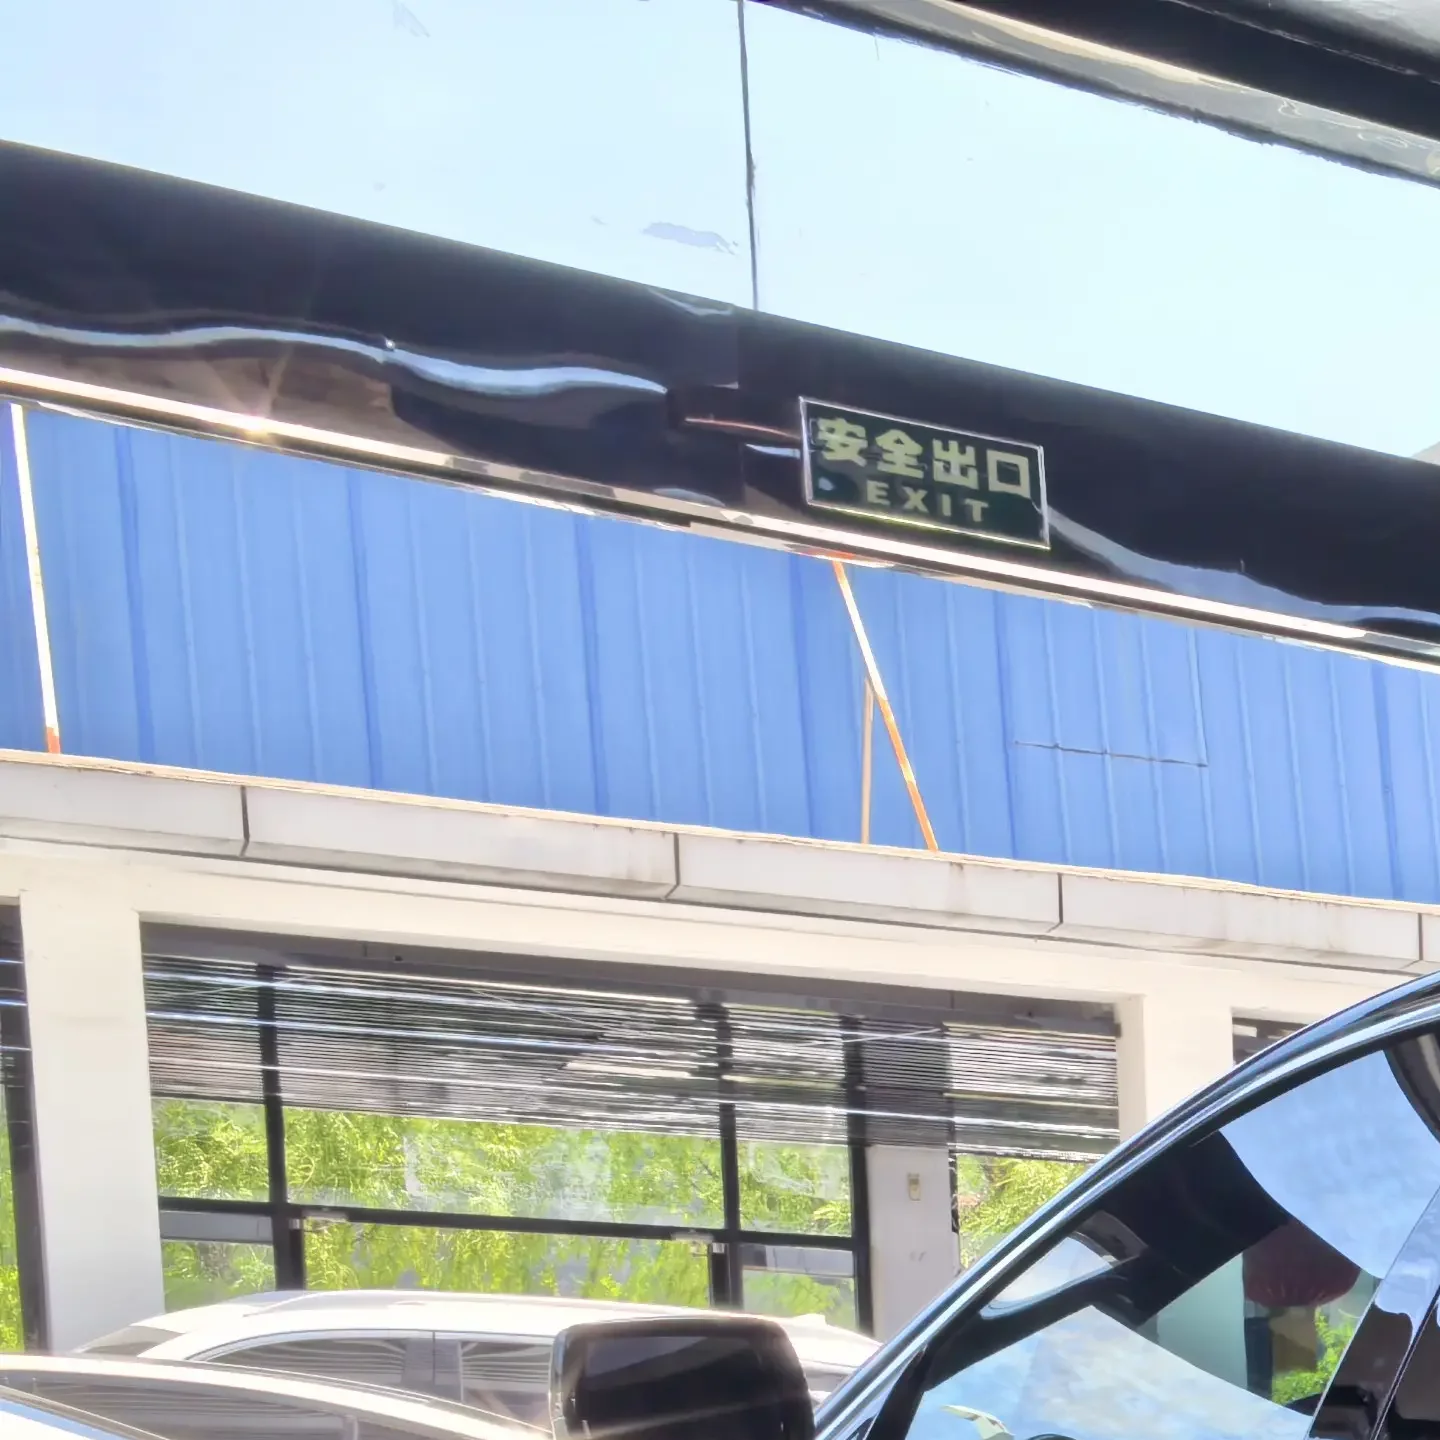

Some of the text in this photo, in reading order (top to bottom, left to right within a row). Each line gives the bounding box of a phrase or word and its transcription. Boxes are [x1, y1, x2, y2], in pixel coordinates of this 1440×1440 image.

[816, 417, 1031, 499] 安全出口
[866, 479, 989, 522] EXIT
